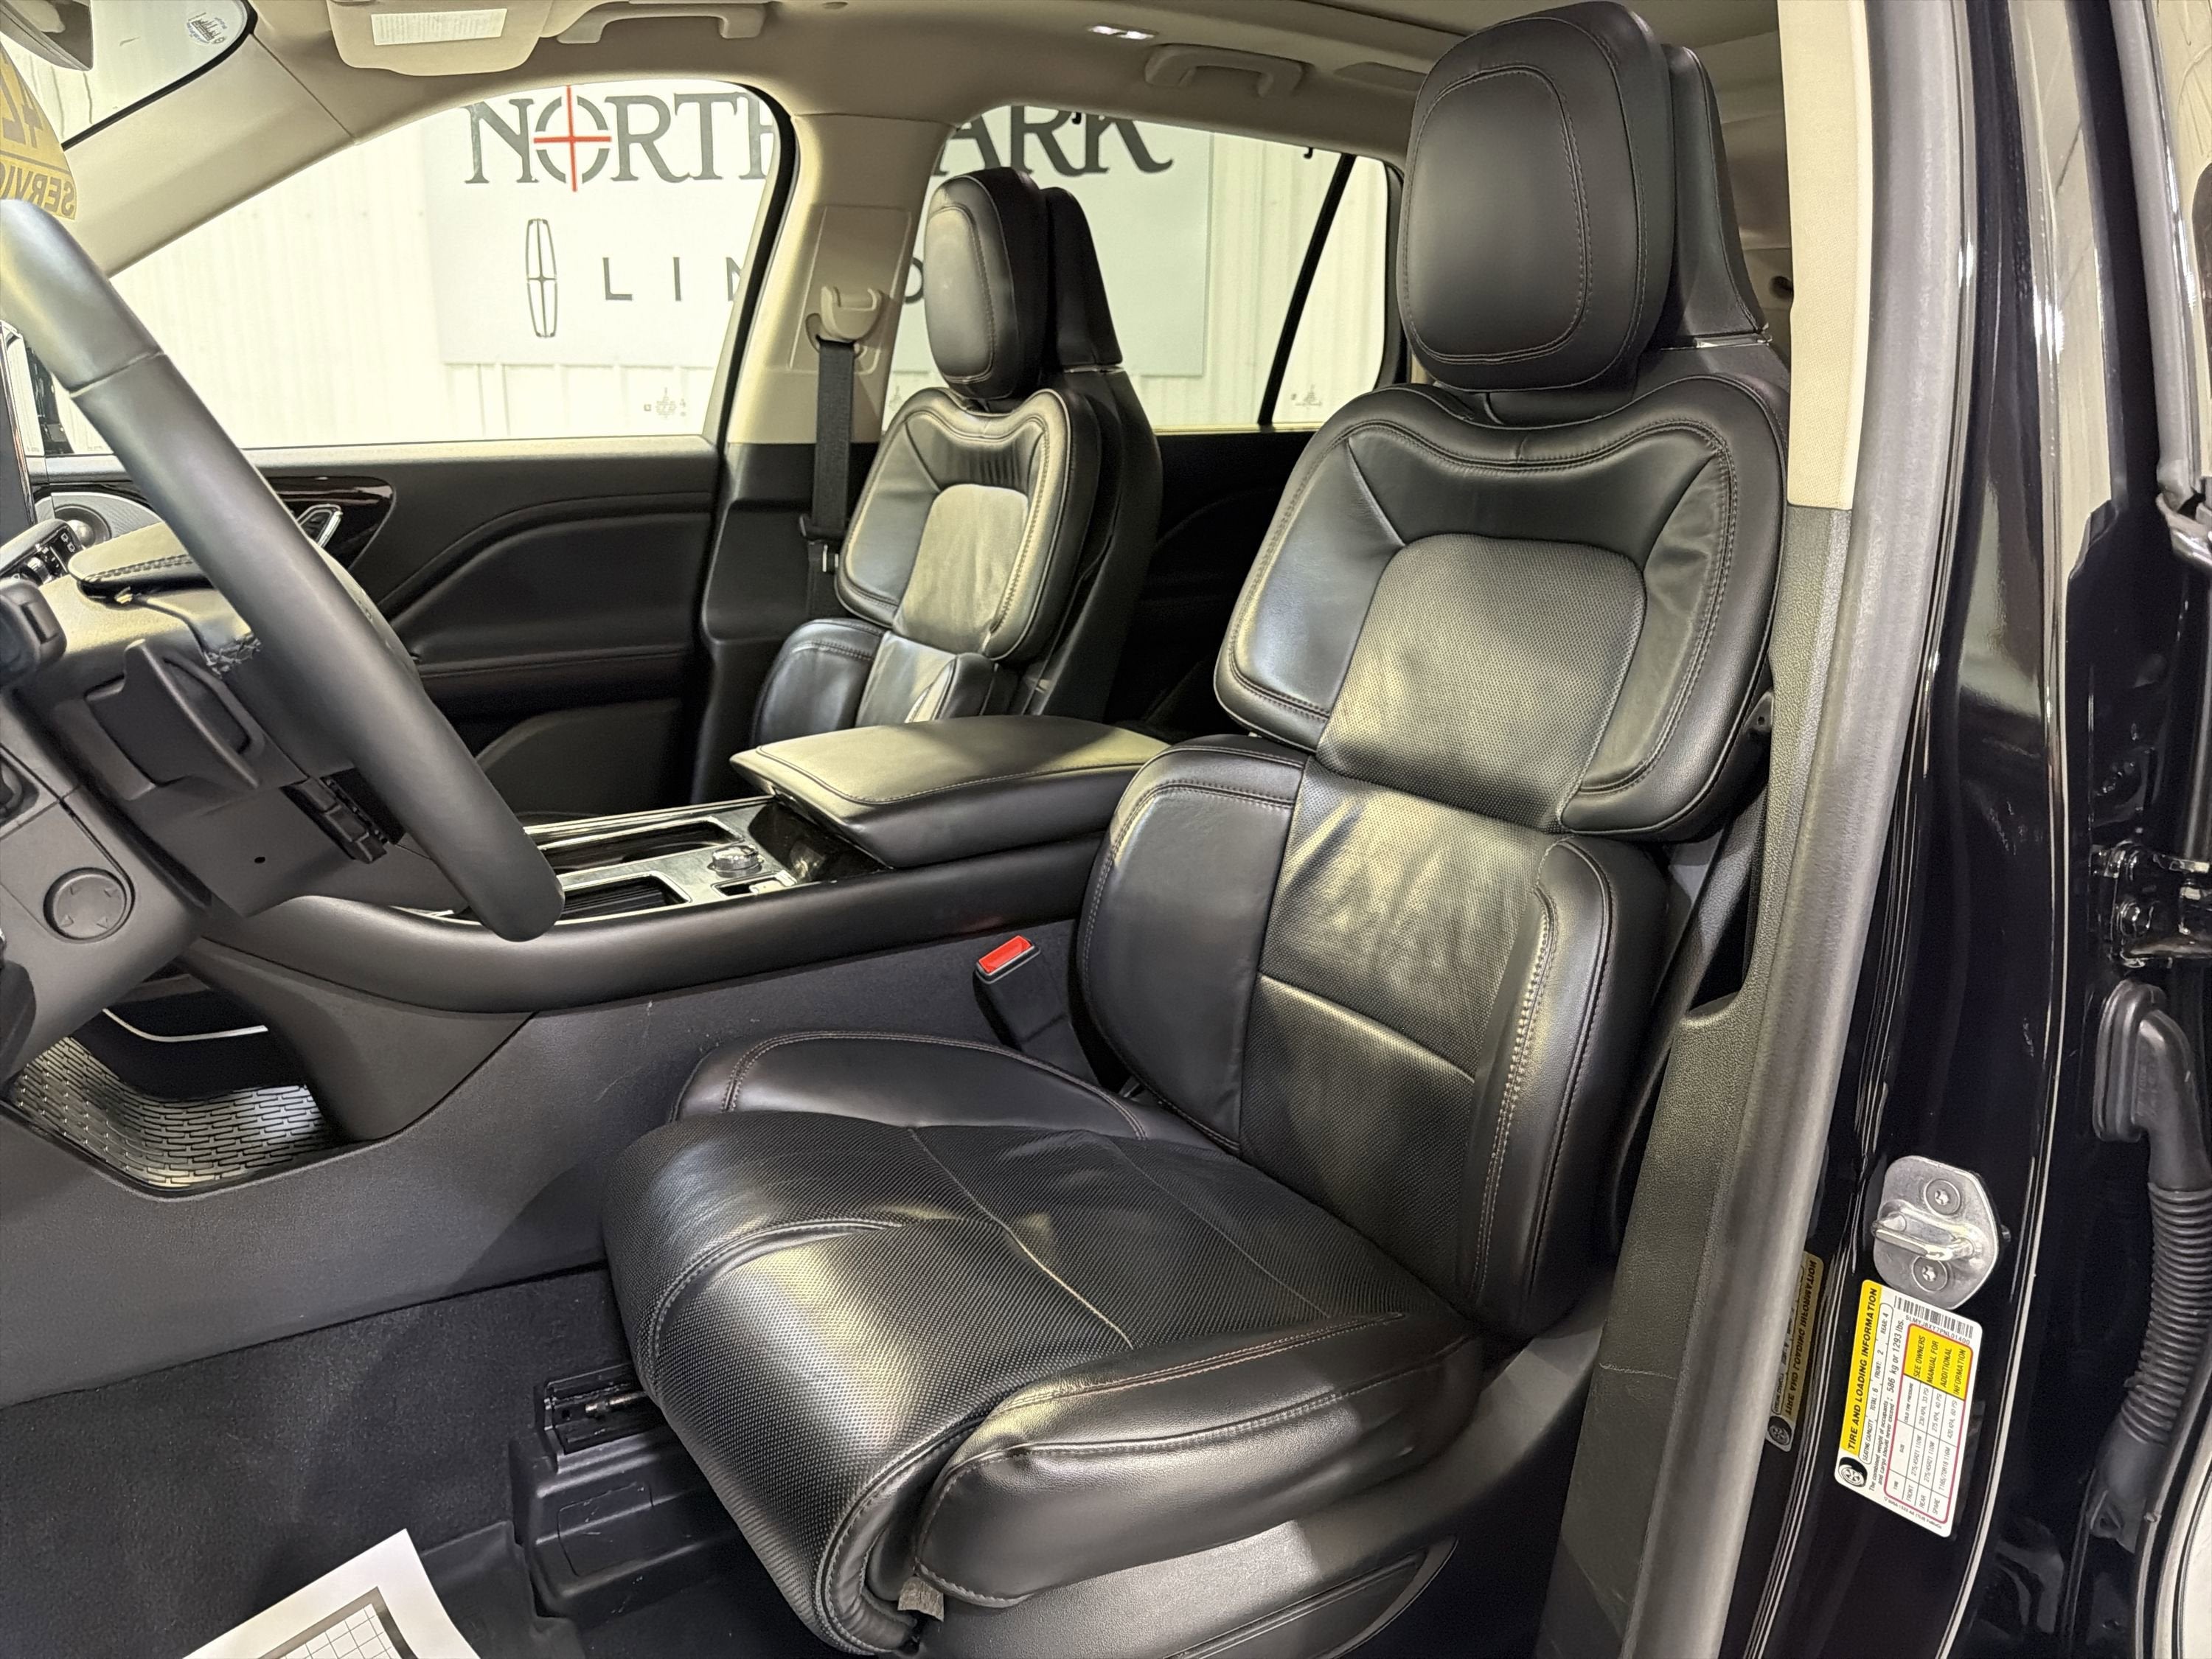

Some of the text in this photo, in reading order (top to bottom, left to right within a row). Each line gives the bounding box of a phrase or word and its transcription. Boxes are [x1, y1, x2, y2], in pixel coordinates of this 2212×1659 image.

[1895, 1319, 1904, 1332] lbs.
[1892, 1332, 1902, 1352] 1293
[1892, 1354, 1899, 1363] or
[1913, 1335, 1925, 1378] SEE OWNERS
[1927, 1340, 1938, 1383] MANUAL FOR
[1848, 1288, 1877, 1449] TIRE AND LOADING INFORMATION
[1889, 1364, 1899, 1374] kg
[1940, 1349, 1952, 1388] ADDITIONAL
[1953, 1349, 1966, 1394] INFORMATION
[1886, 1377, 1895, 1393] 586
[1872, 1454, 1880, 1481] combined
[1932, 1498, 1940, 1514] SPARE
